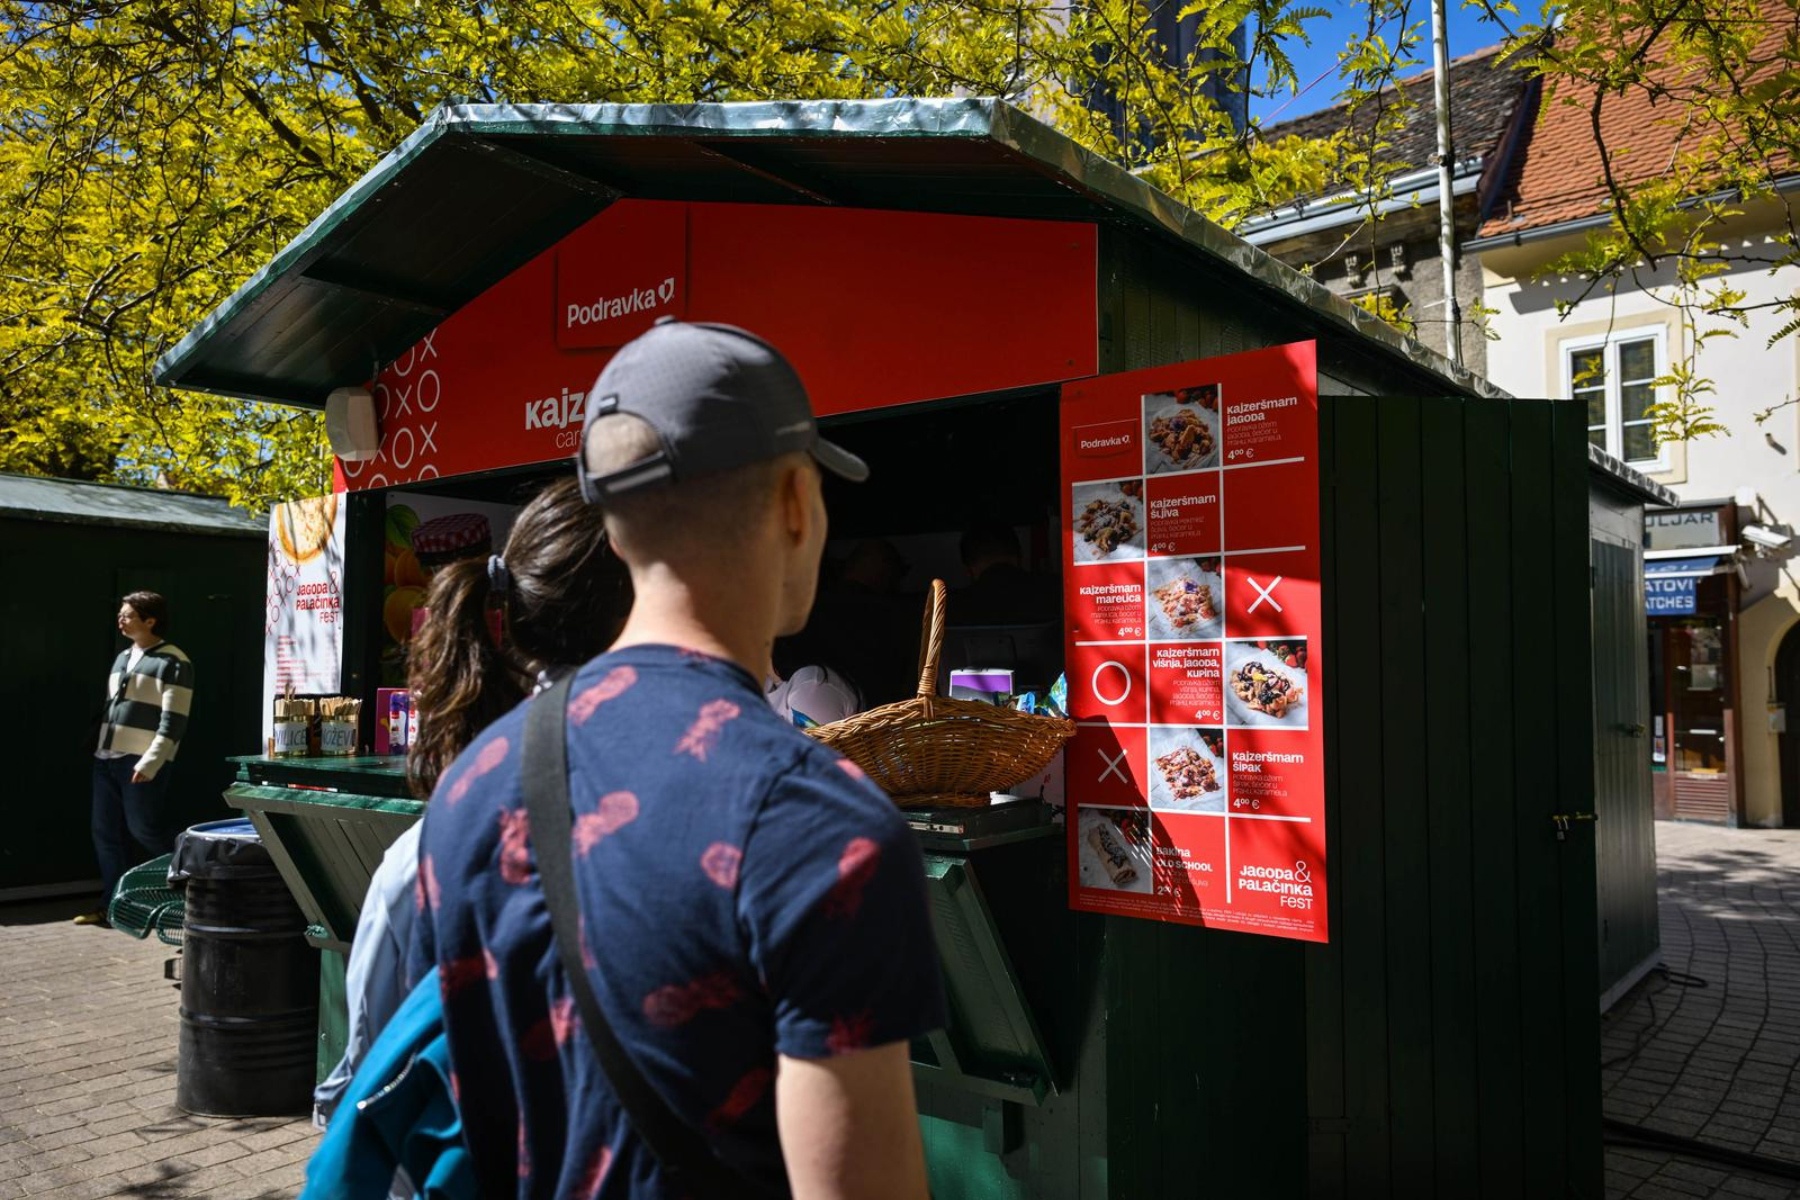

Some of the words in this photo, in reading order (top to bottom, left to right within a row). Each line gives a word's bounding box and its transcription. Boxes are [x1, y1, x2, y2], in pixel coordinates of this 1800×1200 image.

[568, 286, 656, 328] Podravka
[525, 387, 586, 430] kajz
[556, 430, 582, 448] car
[1081, 435, 1121, 449] Podravka
[1295, 860, 1312, 883] &
